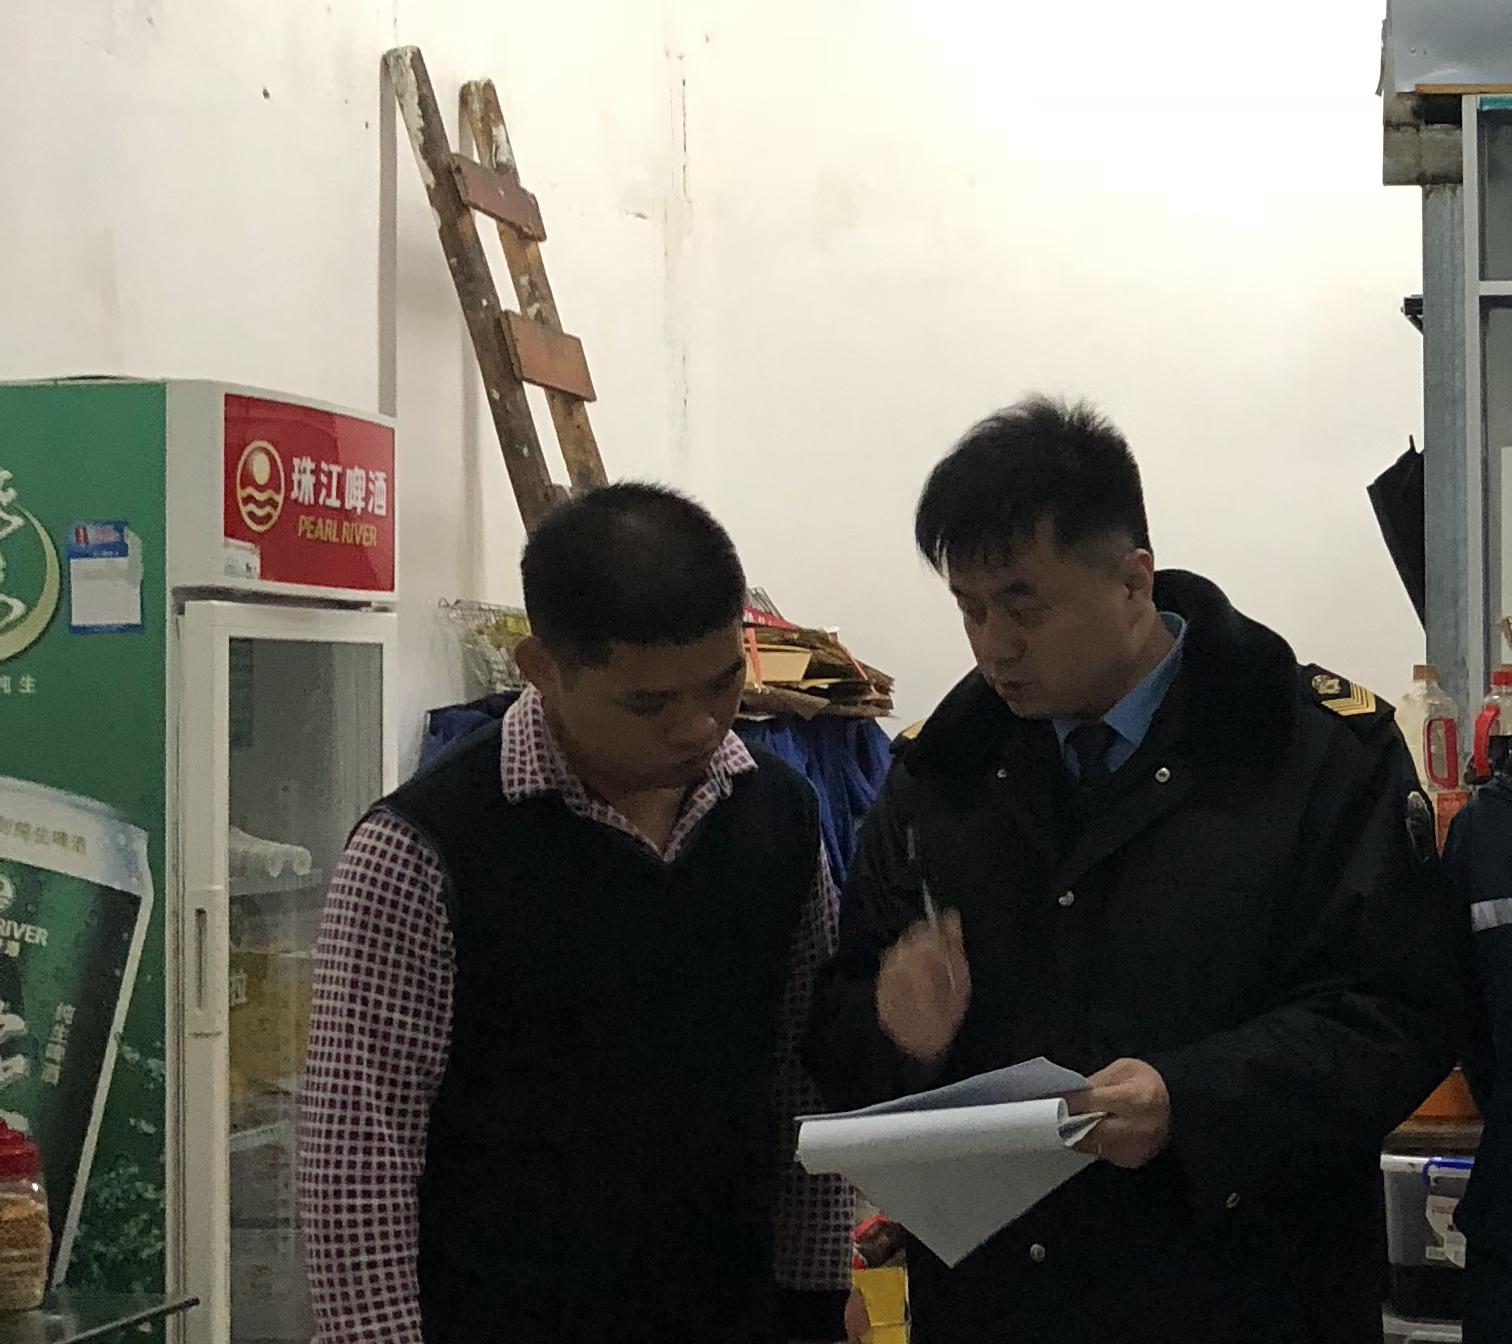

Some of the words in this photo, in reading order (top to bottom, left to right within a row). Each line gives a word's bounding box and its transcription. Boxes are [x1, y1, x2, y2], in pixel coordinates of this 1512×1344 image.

[290, 455, 387, 517] 珠江啤酒
[298, 515, 339, 544] PEARL
[341, 521, 377, 547] RIVER
